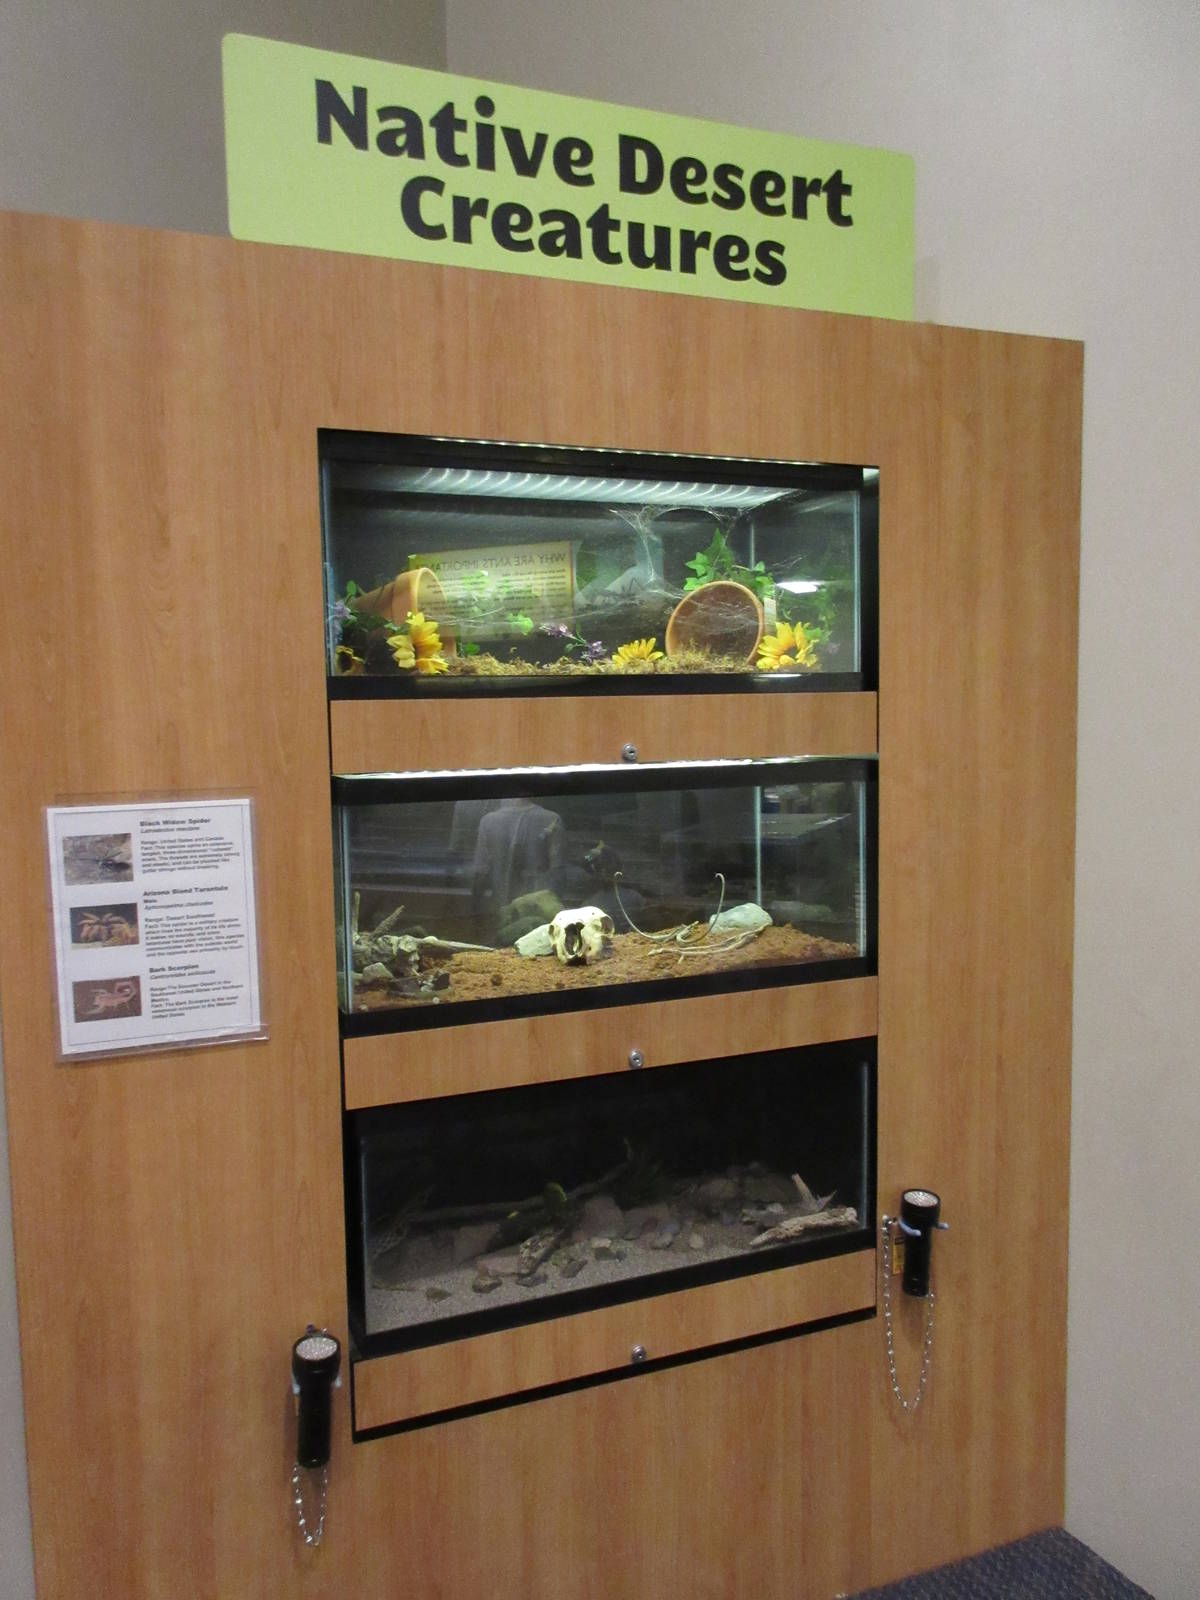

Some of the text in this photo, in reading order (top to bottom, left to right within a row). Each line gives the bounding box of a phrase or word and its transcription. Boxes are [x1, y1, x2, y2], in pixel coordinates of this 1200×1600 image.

[314, 78, 854, 227] Native Desert
[399, 175, 788, 286] Creatures
